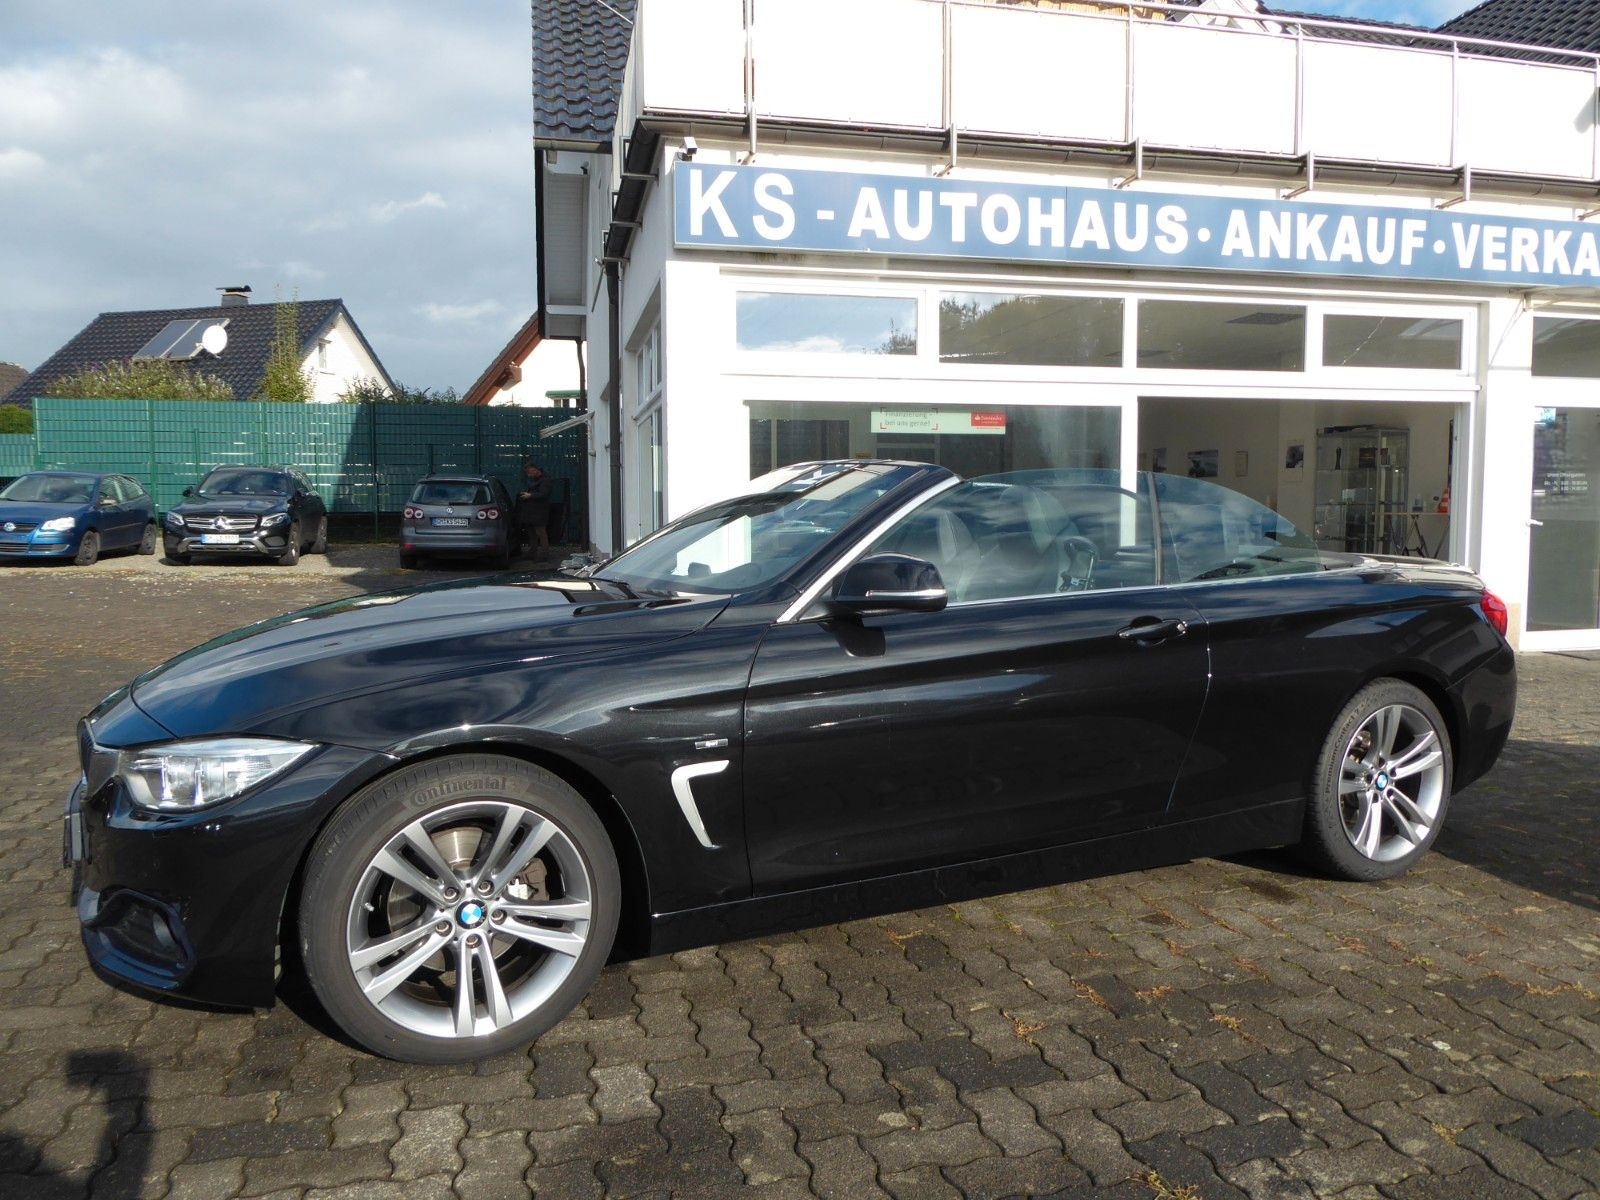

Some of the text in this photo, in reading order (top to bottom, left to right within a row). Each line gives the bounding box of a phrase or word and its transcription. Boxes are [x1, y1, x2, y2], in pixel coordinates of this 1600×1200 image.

[847, 186, 1189, 255] AUTOHAUS
[1221, 209, 1427, 266] ANKAUF
[1452, 221, 1600, 277] VERKA
[409, 777, 507, 808] Continental
